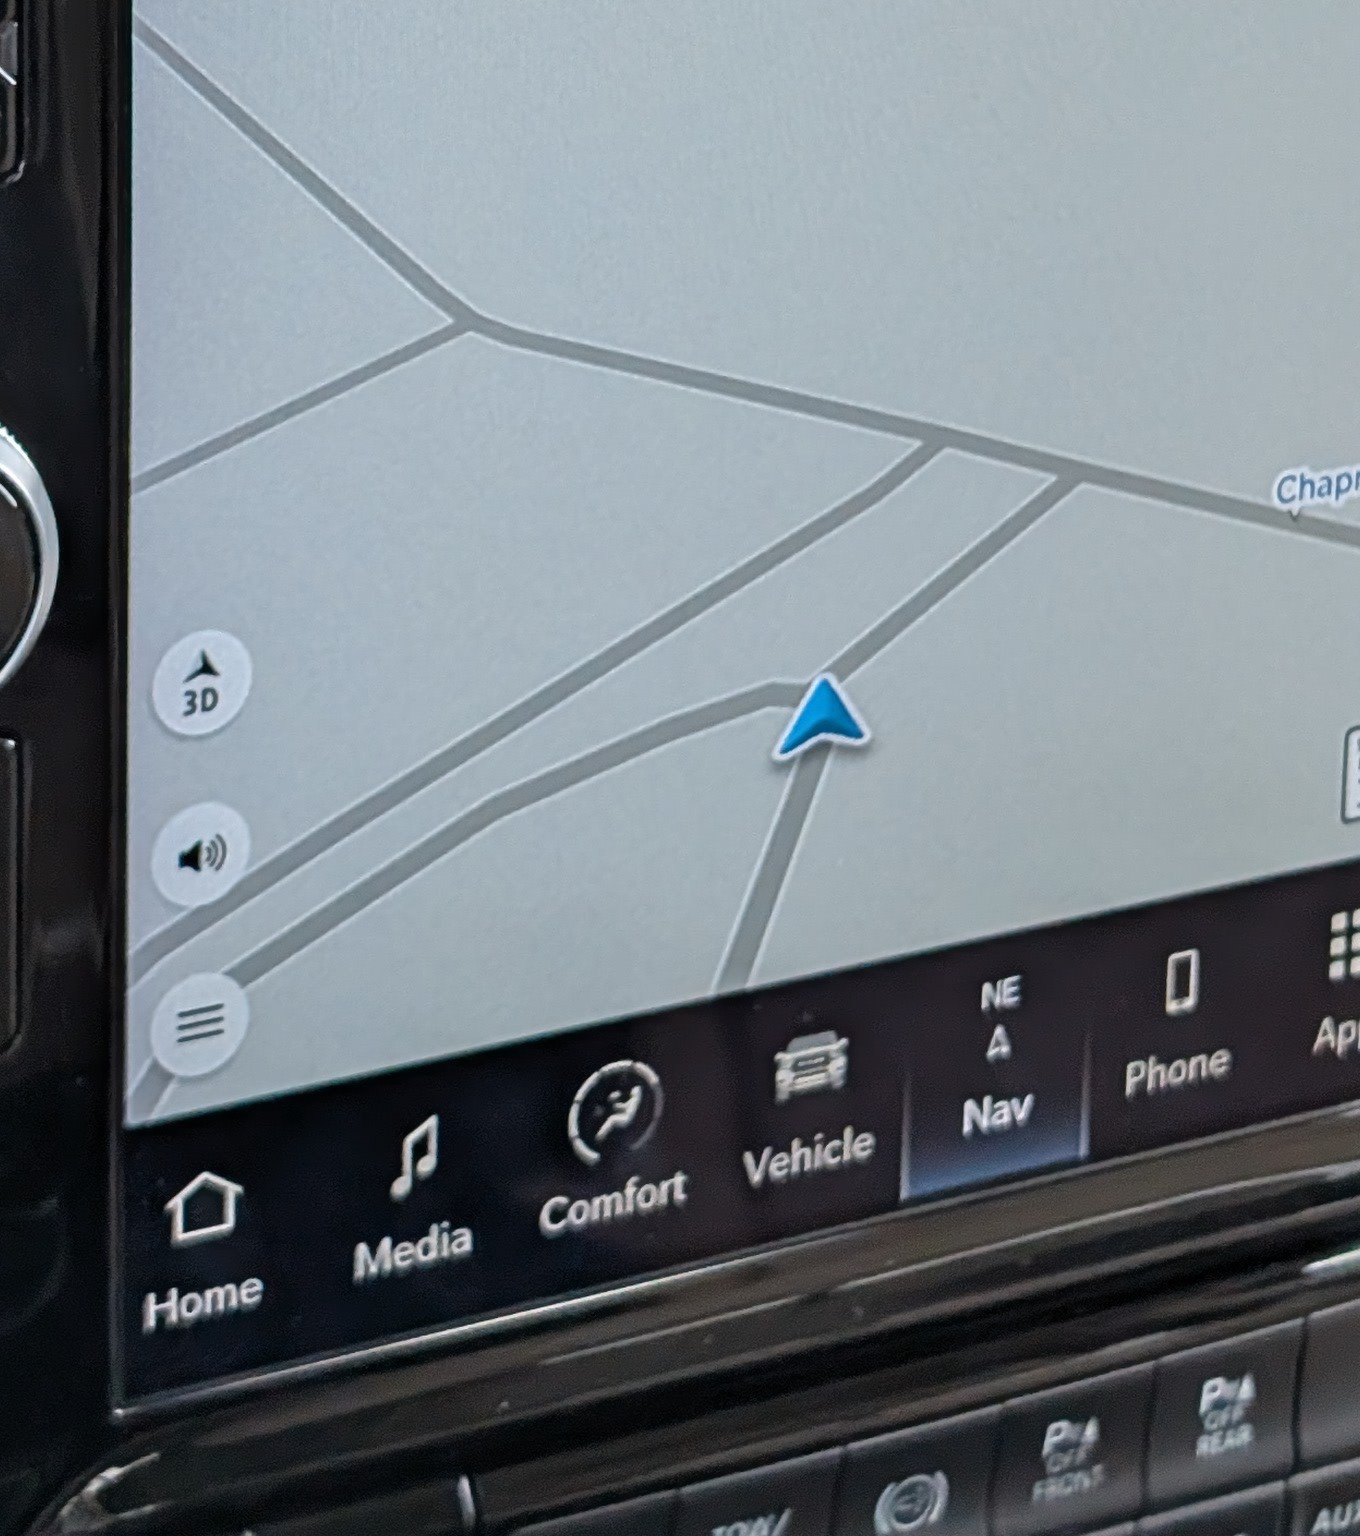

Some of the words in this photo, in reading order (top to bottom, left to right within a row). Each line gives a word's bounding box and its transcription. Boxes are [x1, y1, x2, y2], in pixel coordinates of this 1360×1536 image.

[183, 687, 219, 716] 3D
[981, 976, 1021, 1012] NE
[1125, 1048, 1232, 1099] Phone
[963, 1094, 1034, 1138] Nav
[743, 1126, 876, 1188] Vehicle
[540, 1172, 688, 1236] Comfort
[353, 1223, 474, 1282] Media
[142, 1278, 264, 1335] Home
